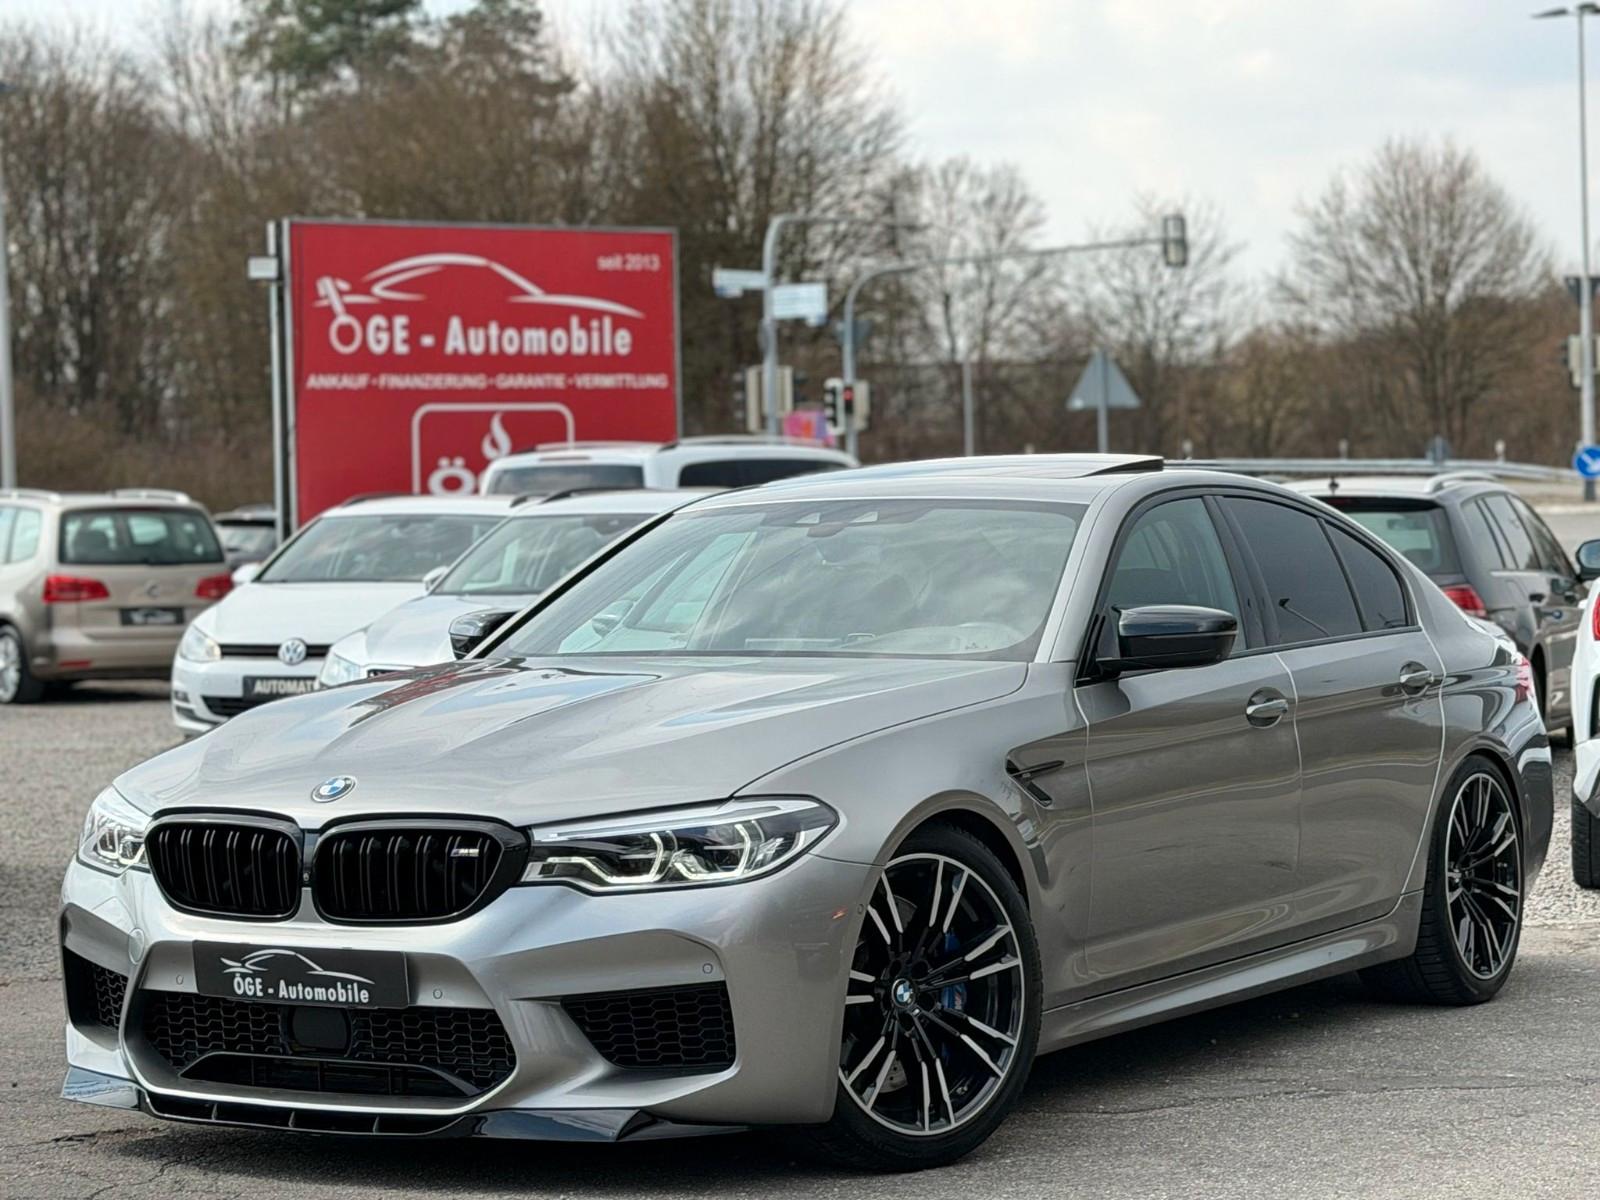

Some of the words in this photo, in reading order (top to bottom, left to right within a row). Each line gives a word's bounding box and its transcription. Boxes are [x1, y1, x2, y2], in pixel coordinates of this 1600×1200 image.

[444, 314, 633, 356] Automobile
[306, 373, 370, 390] ANKAUF
[378, 373, 487, 390] FINANZIERUNG
[495, 373, 566, 390] GARANTIE
[573, 373, 669, 390] VERMITTLUNG
[254, 679, 318, 694] AUTOMAT
[233, 973, 264, 997] ÖGE
[278, 979, 370, 1003] Automobile
